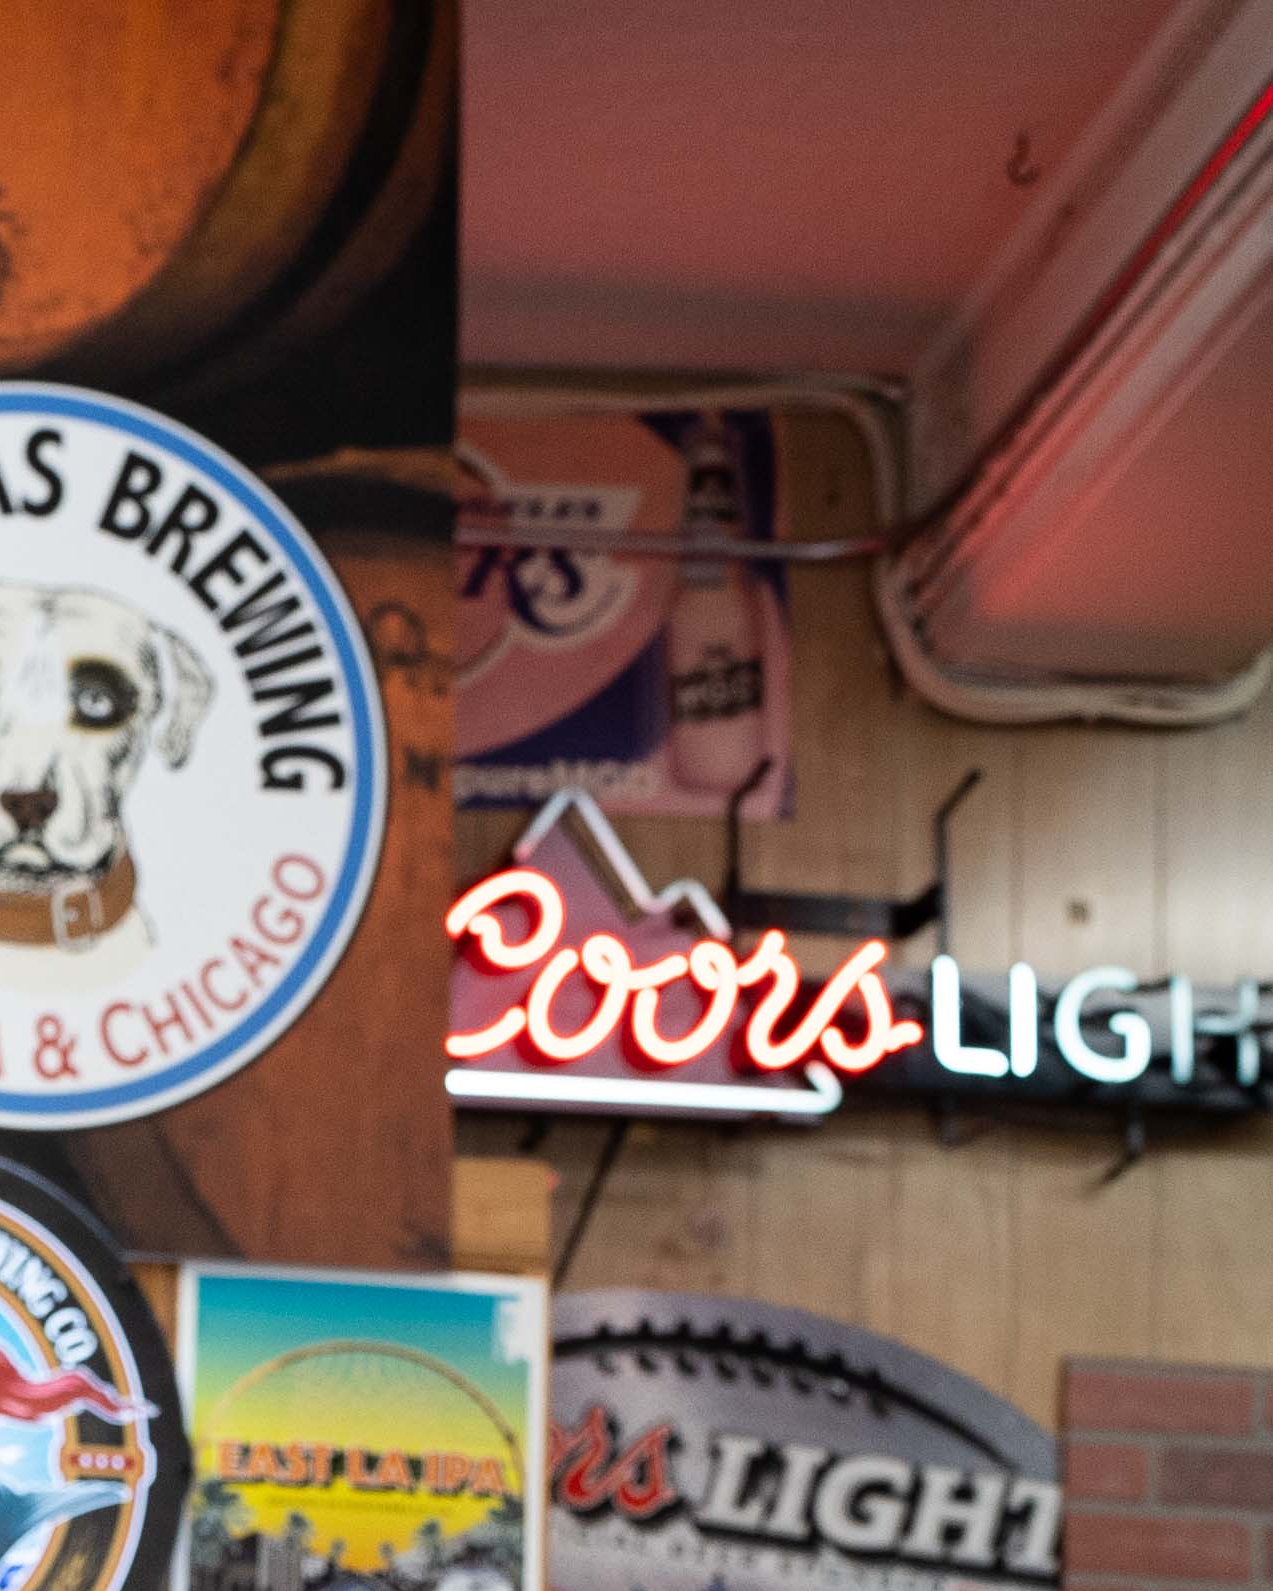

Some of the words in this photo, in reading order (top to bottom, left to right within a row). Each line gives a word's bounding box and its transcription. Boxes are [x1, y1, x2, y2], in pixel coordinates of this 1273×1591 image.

[98, 452, 347, 797] BREWING
[33, 1015, 80, 1082] &
[98, 852, 327, 1069] CHICAGO
[445, 869, 922, 1073] Coors
[215, 1439, 335, 1484] EAST
[346, 1448, 413, 1489] LA
[424, 1451, 508, 1496] IPA
